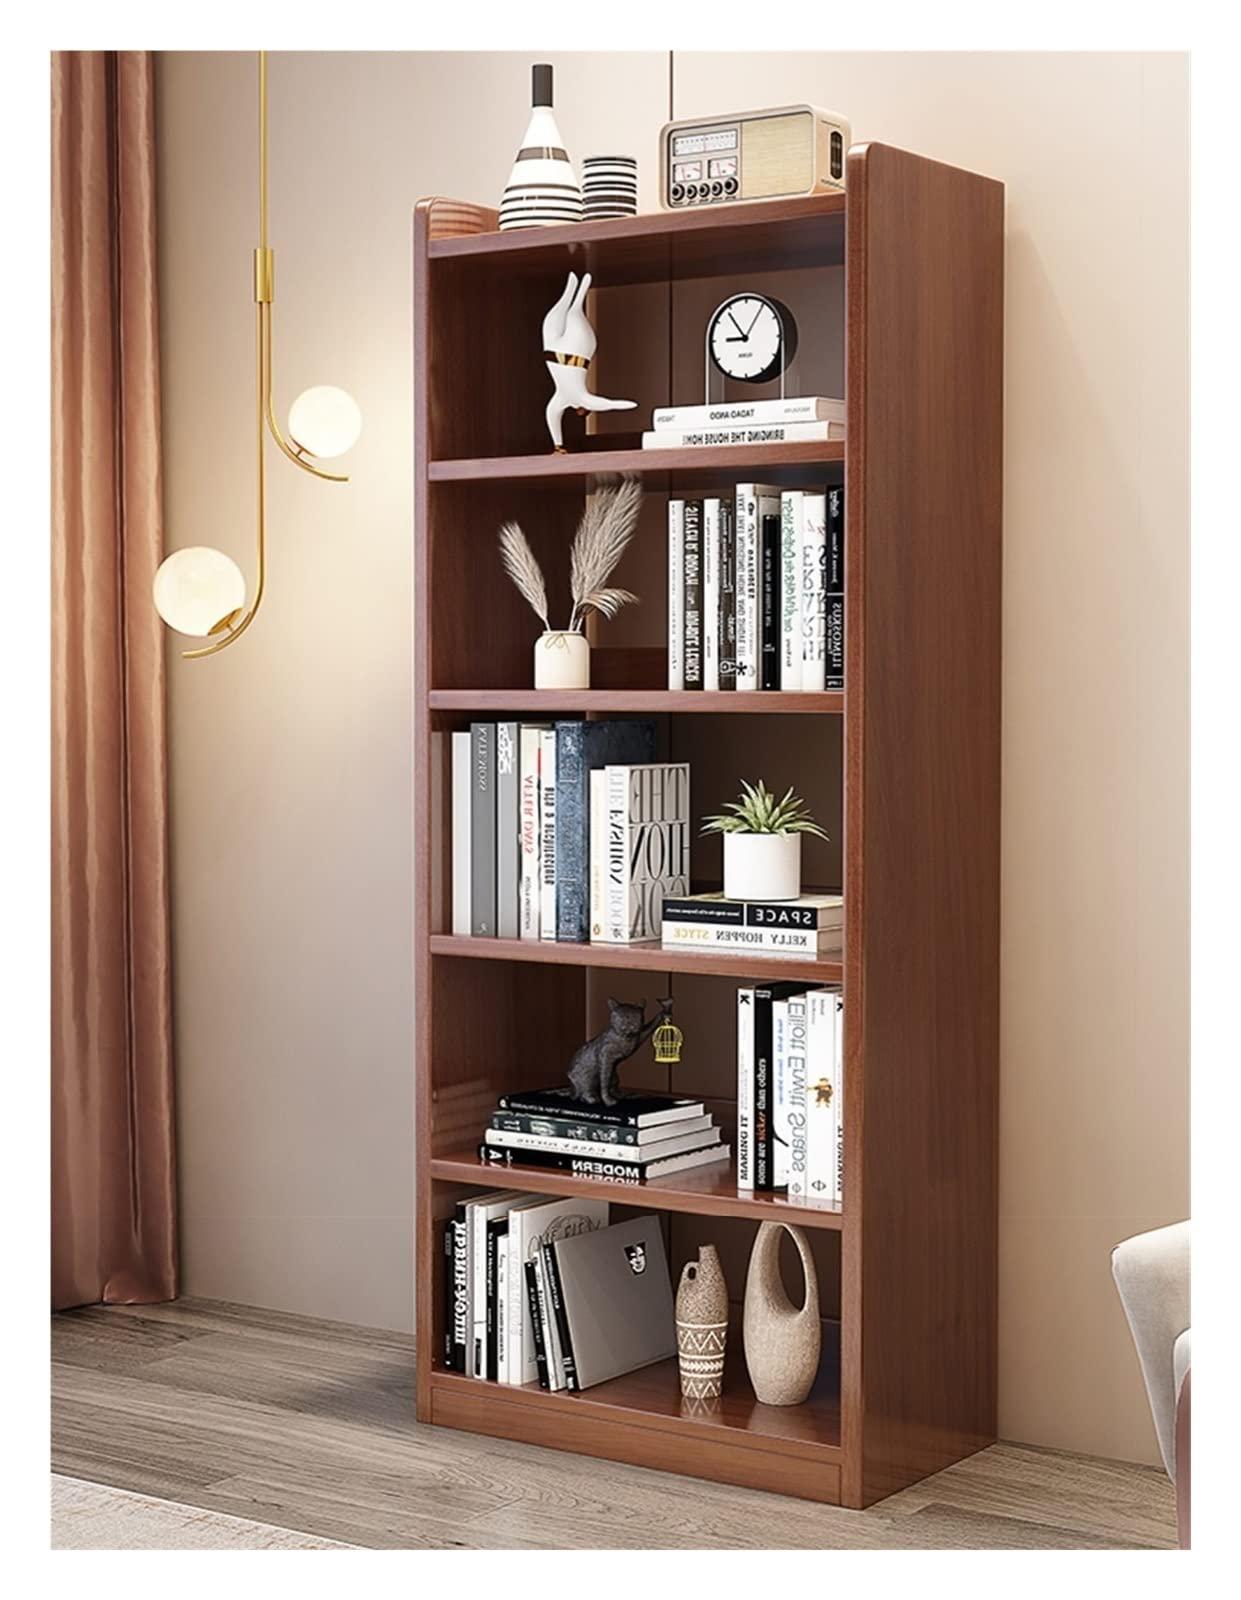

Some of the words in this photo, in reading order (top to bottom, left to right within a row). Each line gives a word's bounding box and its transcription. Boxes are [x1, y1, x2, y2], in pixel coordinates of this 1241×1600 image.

[755, 1058, 767, 1088] others
[755, 1088, 767, 1110] than
[740, 1114, 749, 1129] IT
[755, 1111, 767, 1141] sicker
[740, 1130, 749, 1181] MAKING
[757, 1142, 767, 1158] are
[756, 1159, 767, 1185] some
